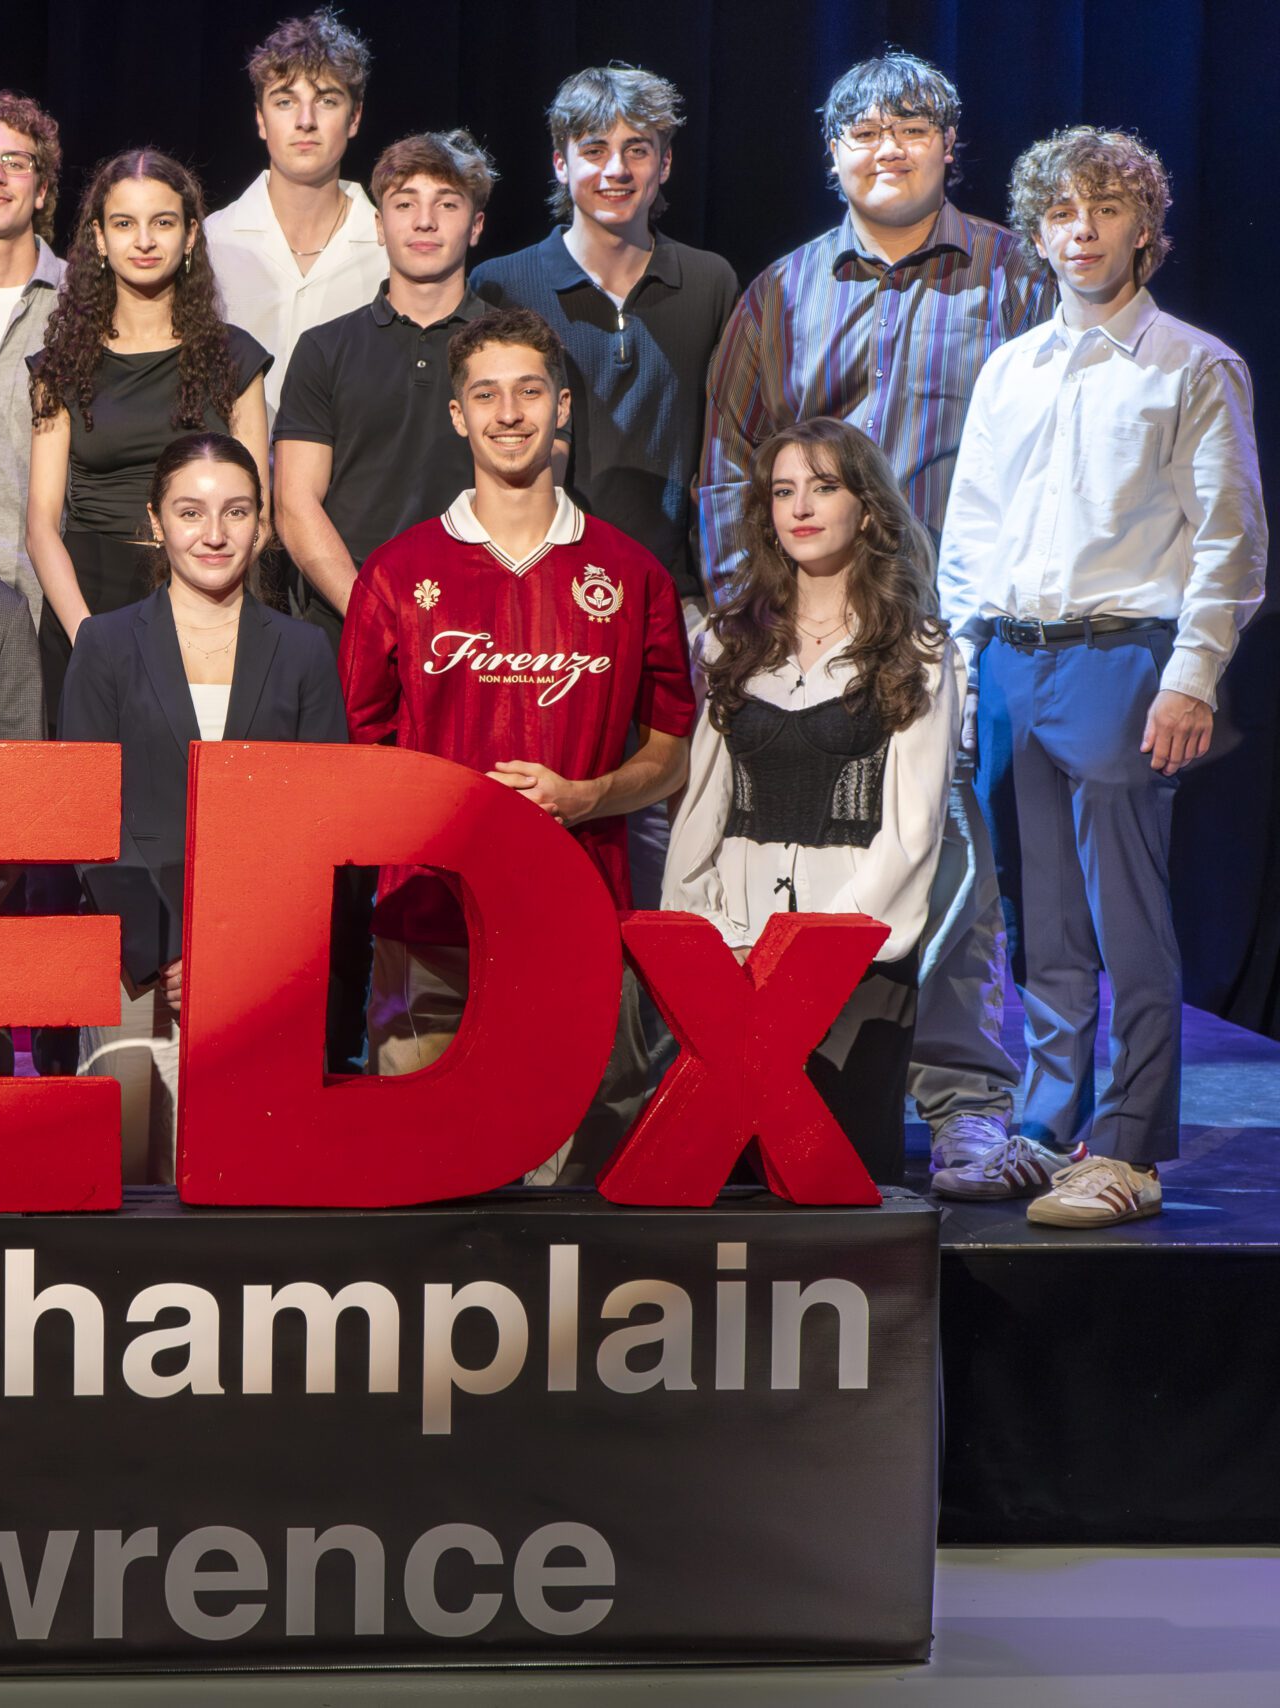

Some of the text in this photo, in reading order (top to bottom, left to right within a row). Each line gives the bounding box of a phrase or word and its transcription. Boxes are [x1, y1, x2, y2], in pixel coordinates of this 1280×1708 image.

[423, 630, 611, 707] Firenze
[479, 674, 555, 684] NON MOLLA MAI
